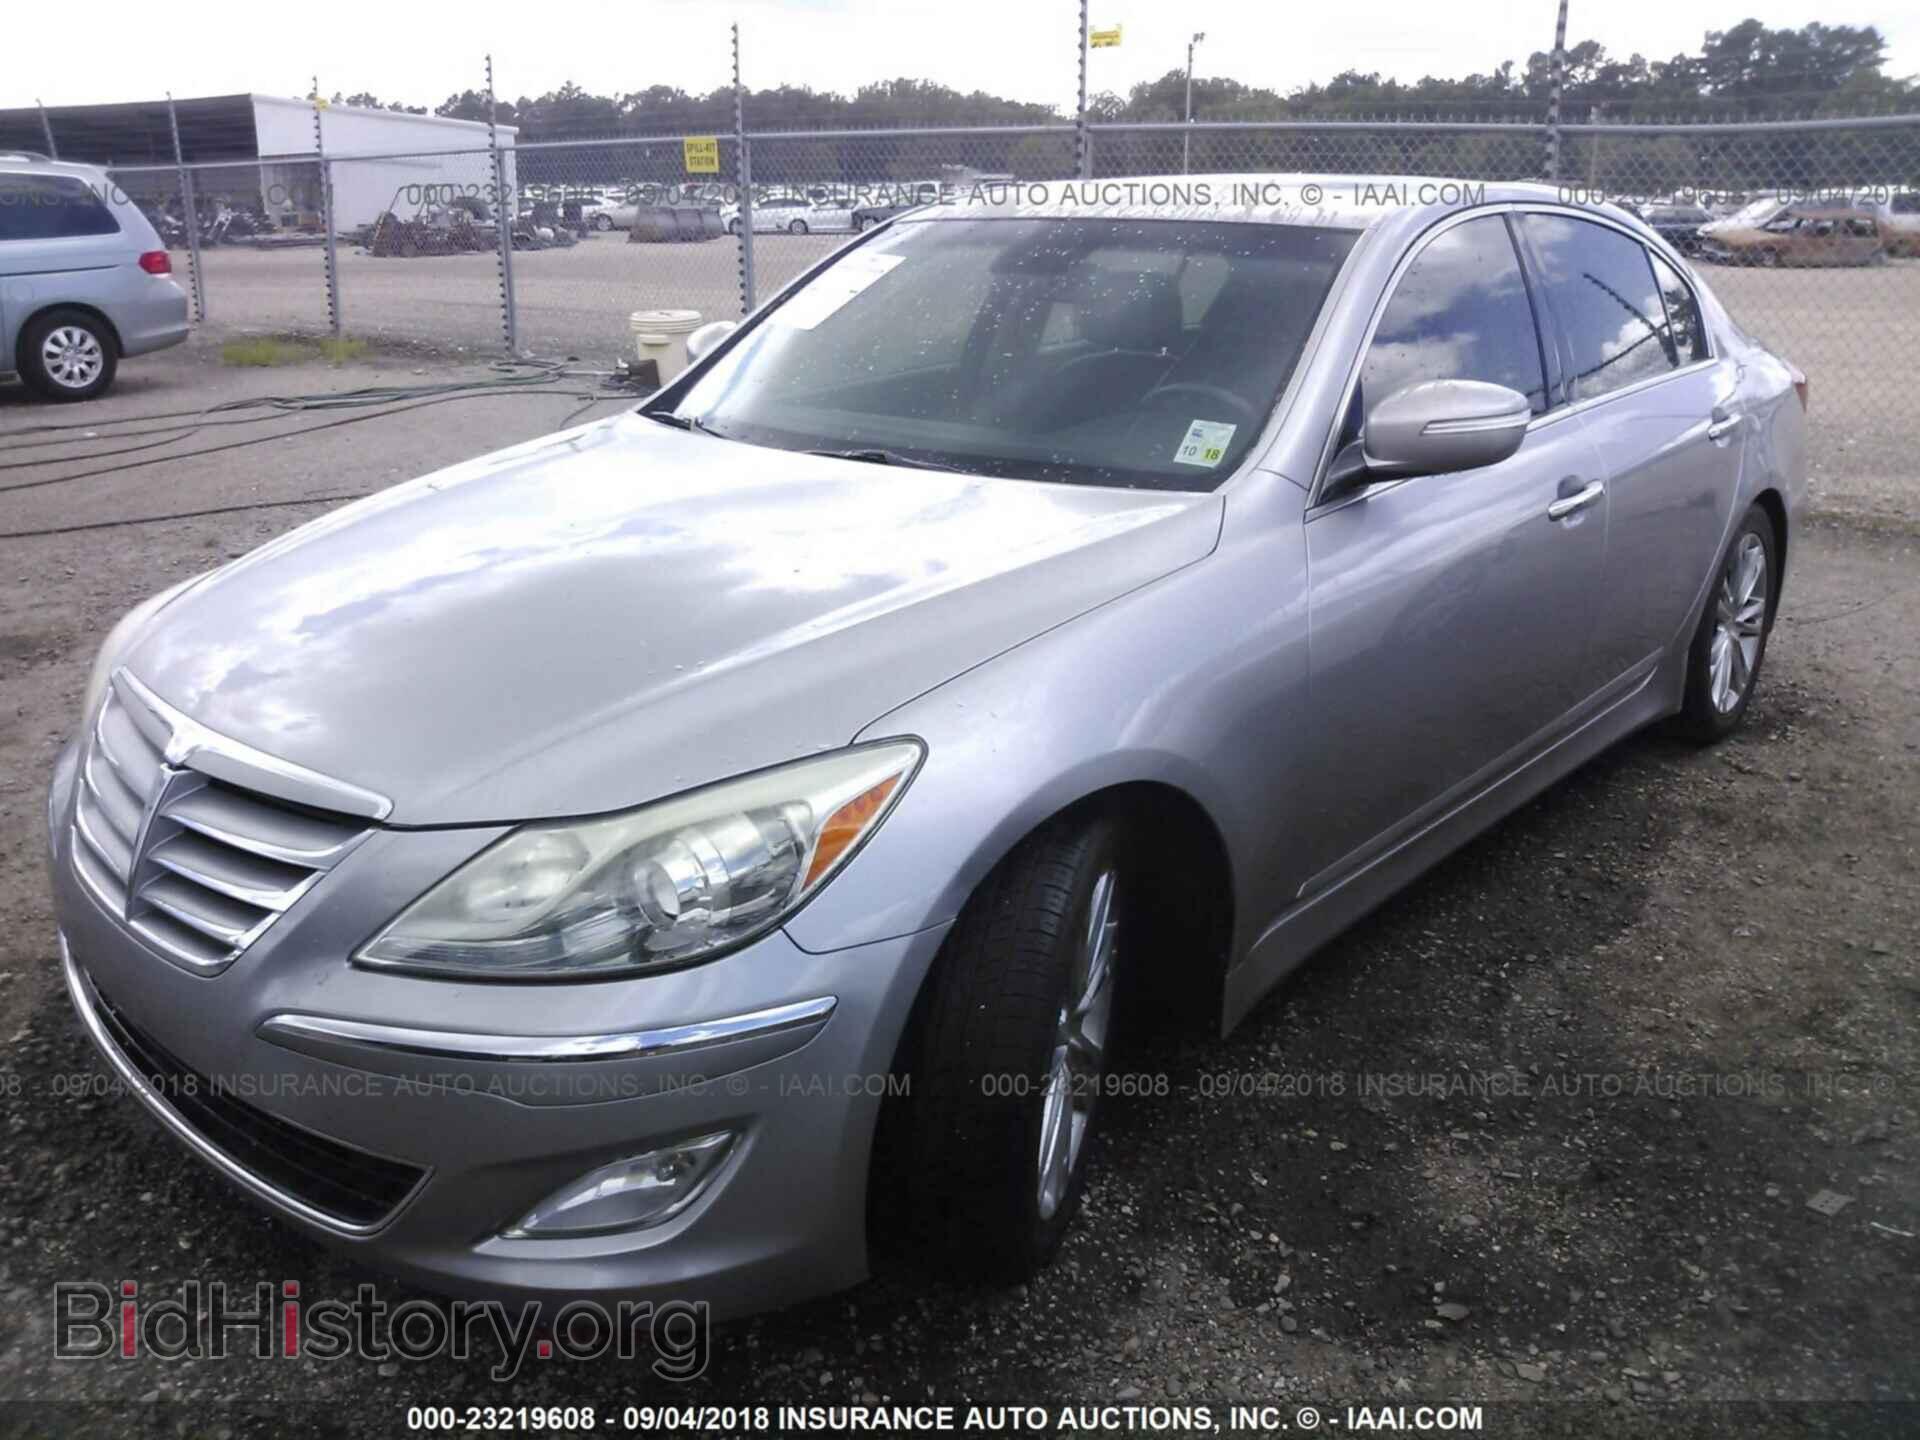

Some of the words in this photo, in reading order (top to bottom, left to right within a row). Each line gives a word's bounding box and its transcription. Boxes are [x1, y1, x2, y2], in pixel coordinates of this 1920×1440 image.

[689, 156, 715, 166] STATION
[1183, 446, 1197, 456] 10
[1205, 448, 1221, 460] 18
